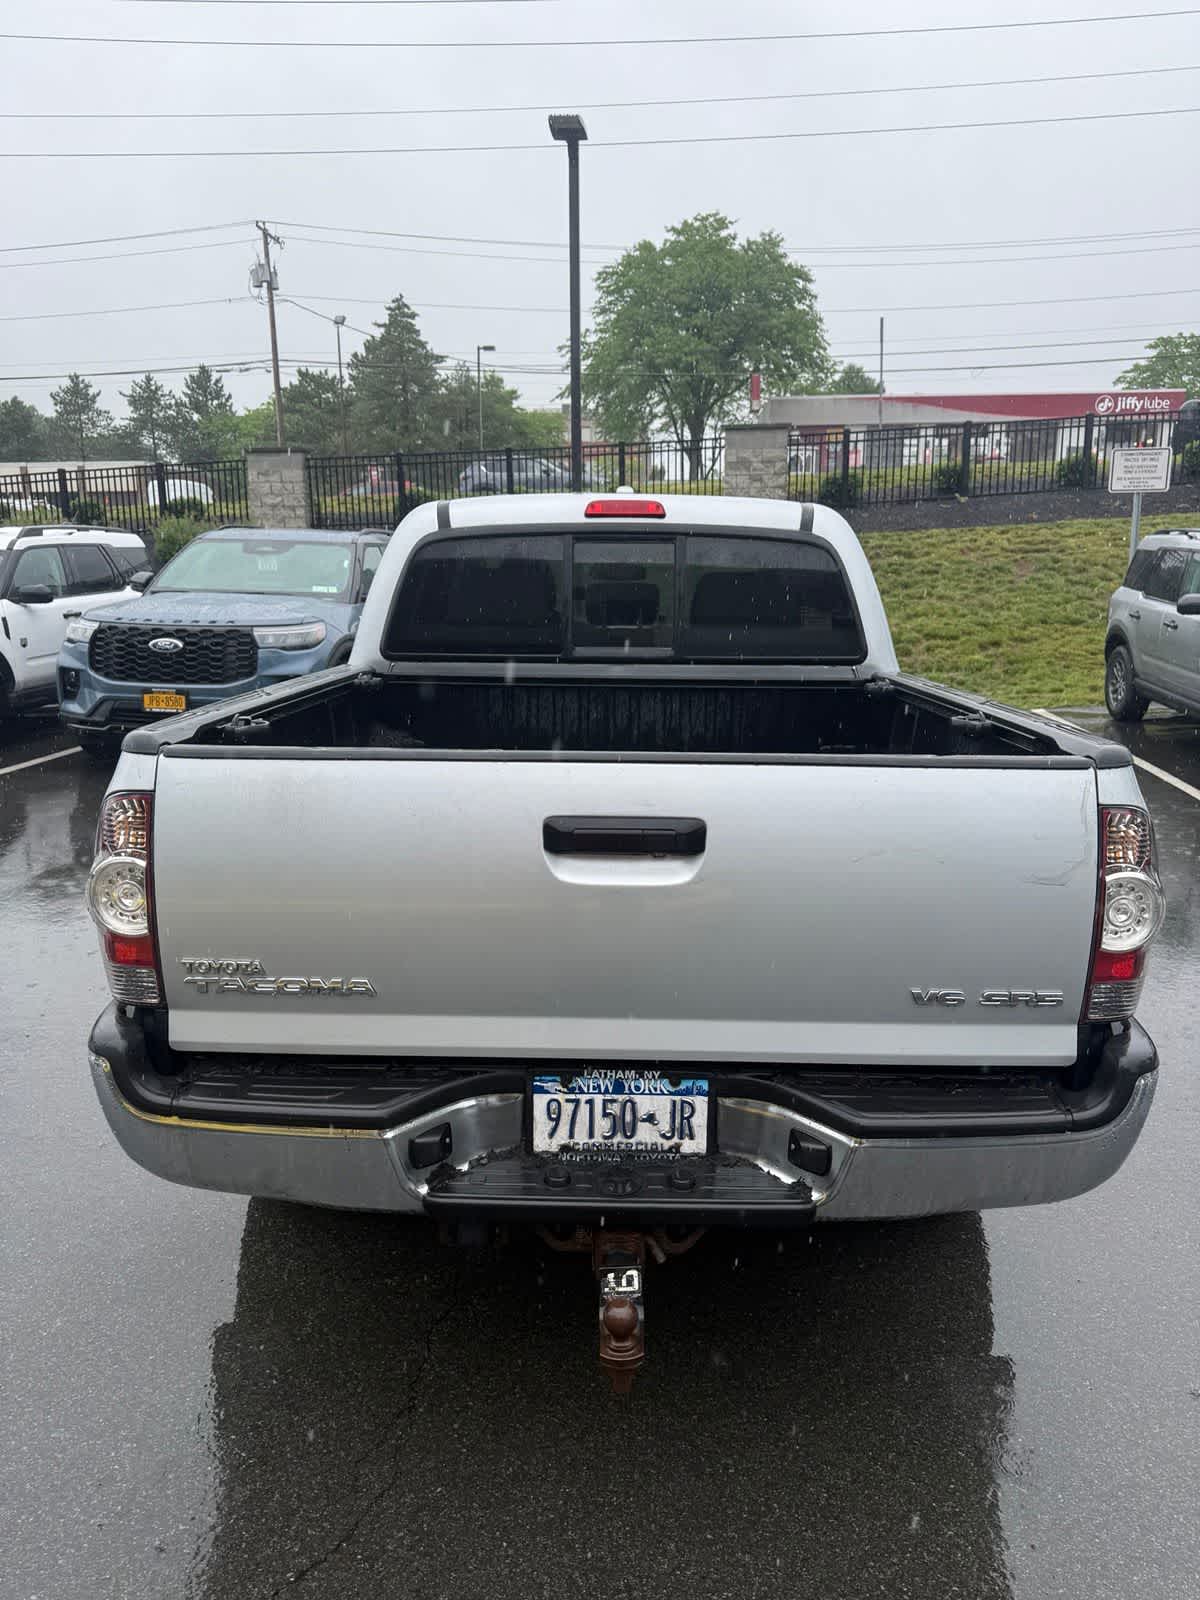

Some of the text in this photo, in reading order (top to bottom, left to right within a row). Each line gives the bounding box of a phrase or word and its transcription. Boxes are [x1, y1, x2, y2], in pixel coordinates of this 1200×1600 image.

[1144, 396, 1170, 409] lube
[181, 957, 266, 975] TOYOTA
[183, 976, 378, 997] TACOMA
[911, 989, 1064, 1007] V6 SR5
[643, 1070, 661, 1080] NY
[576, 1077, 670, 1095] NEW YORK
[546, 1097, 696, 1141] 97150 JR
